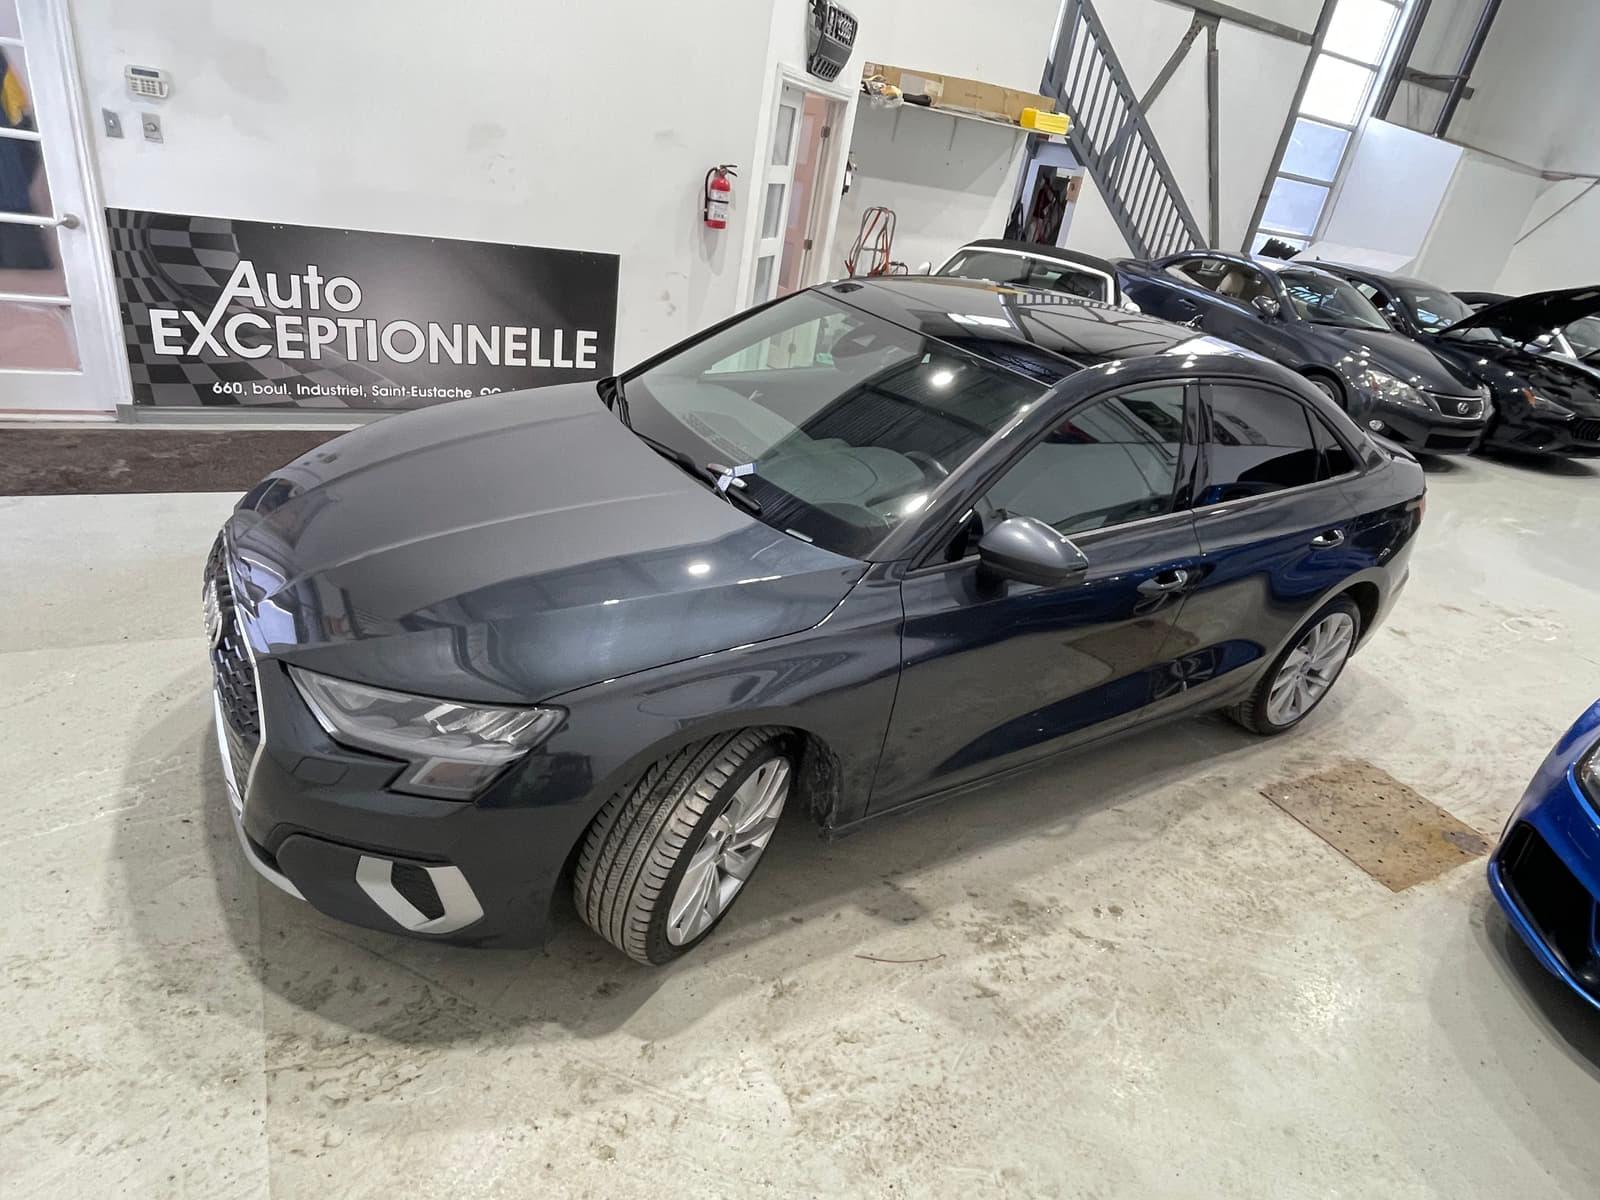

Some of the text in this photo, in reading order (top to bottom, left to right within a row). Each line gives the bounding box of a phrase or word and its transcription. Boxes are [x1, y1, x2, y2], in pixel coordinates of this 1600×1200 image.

[214, 259, 362, 313] Auto
[149, 307, 599, 370] EXCEPTIONNELLE
[212, 381, 248, 397] 660,
[252, 382, 292, 396] boul.
[296, 383, 368, 399] Industriel,
